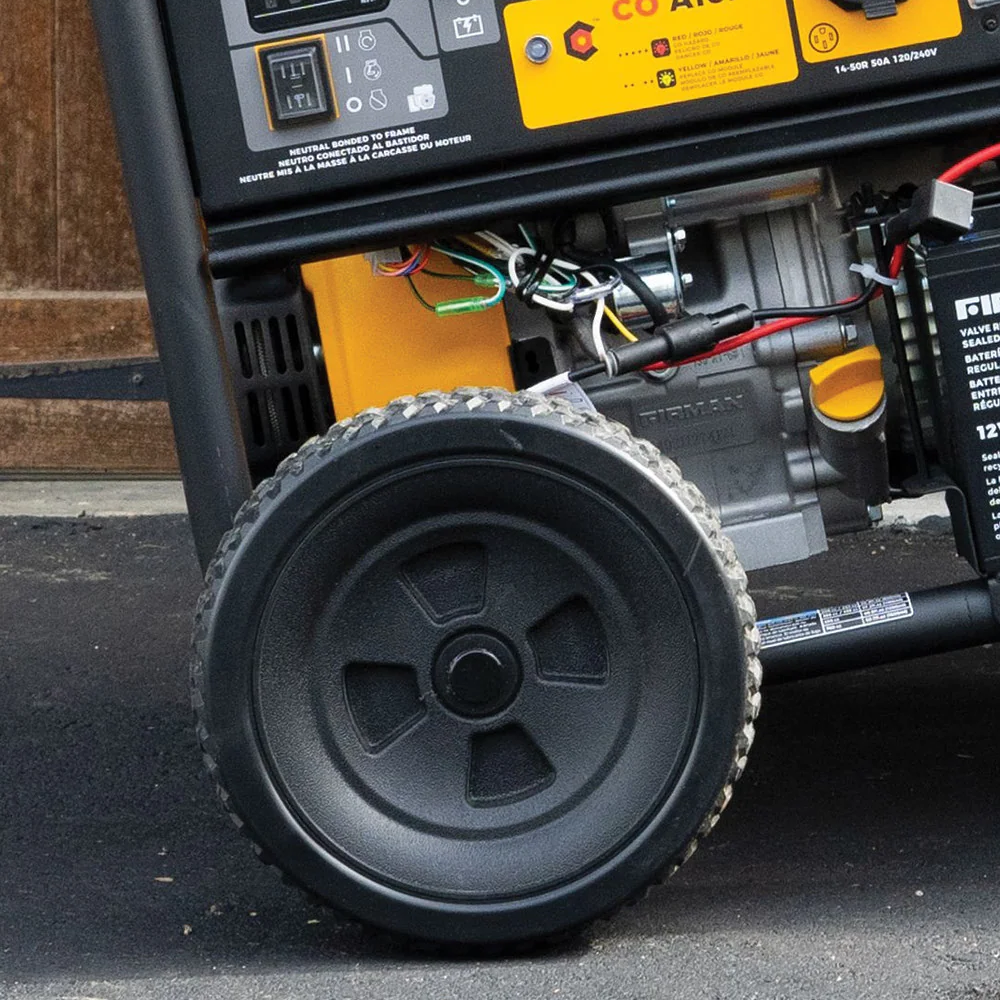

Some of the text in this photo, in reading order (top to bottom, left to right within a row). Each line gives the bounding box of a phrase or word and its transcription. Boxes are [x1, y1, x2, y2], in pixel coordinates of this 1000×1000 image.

[835, 47, 937, 73] 14-50R 50A 120/240V
[278, 133, 429, 167] NEUTRO CONECTADO AL BASTIDOR
[289, 143, 330, 156] NEUTRAL
[331, 135, 369, 148] BONDED
[384, 126, 415, 138] FRAME
[239, 171, 274, 183] NEUTRE
[276, 168, 292, 176] MIS
[295, 165, 301, 173] À
[317, 157, 347, 169] MASSE
[349, 155, 356, 163] À
[358, 153, 370, 161] LA
[371, 144, 418, 158] CARCASSE
[419, 141, 433, 150] DU
[434, 134, 471, 147] MOTEUR
[960, 324, 991, 337] VALVE
[962, 334, 1000, 348] SEALED
